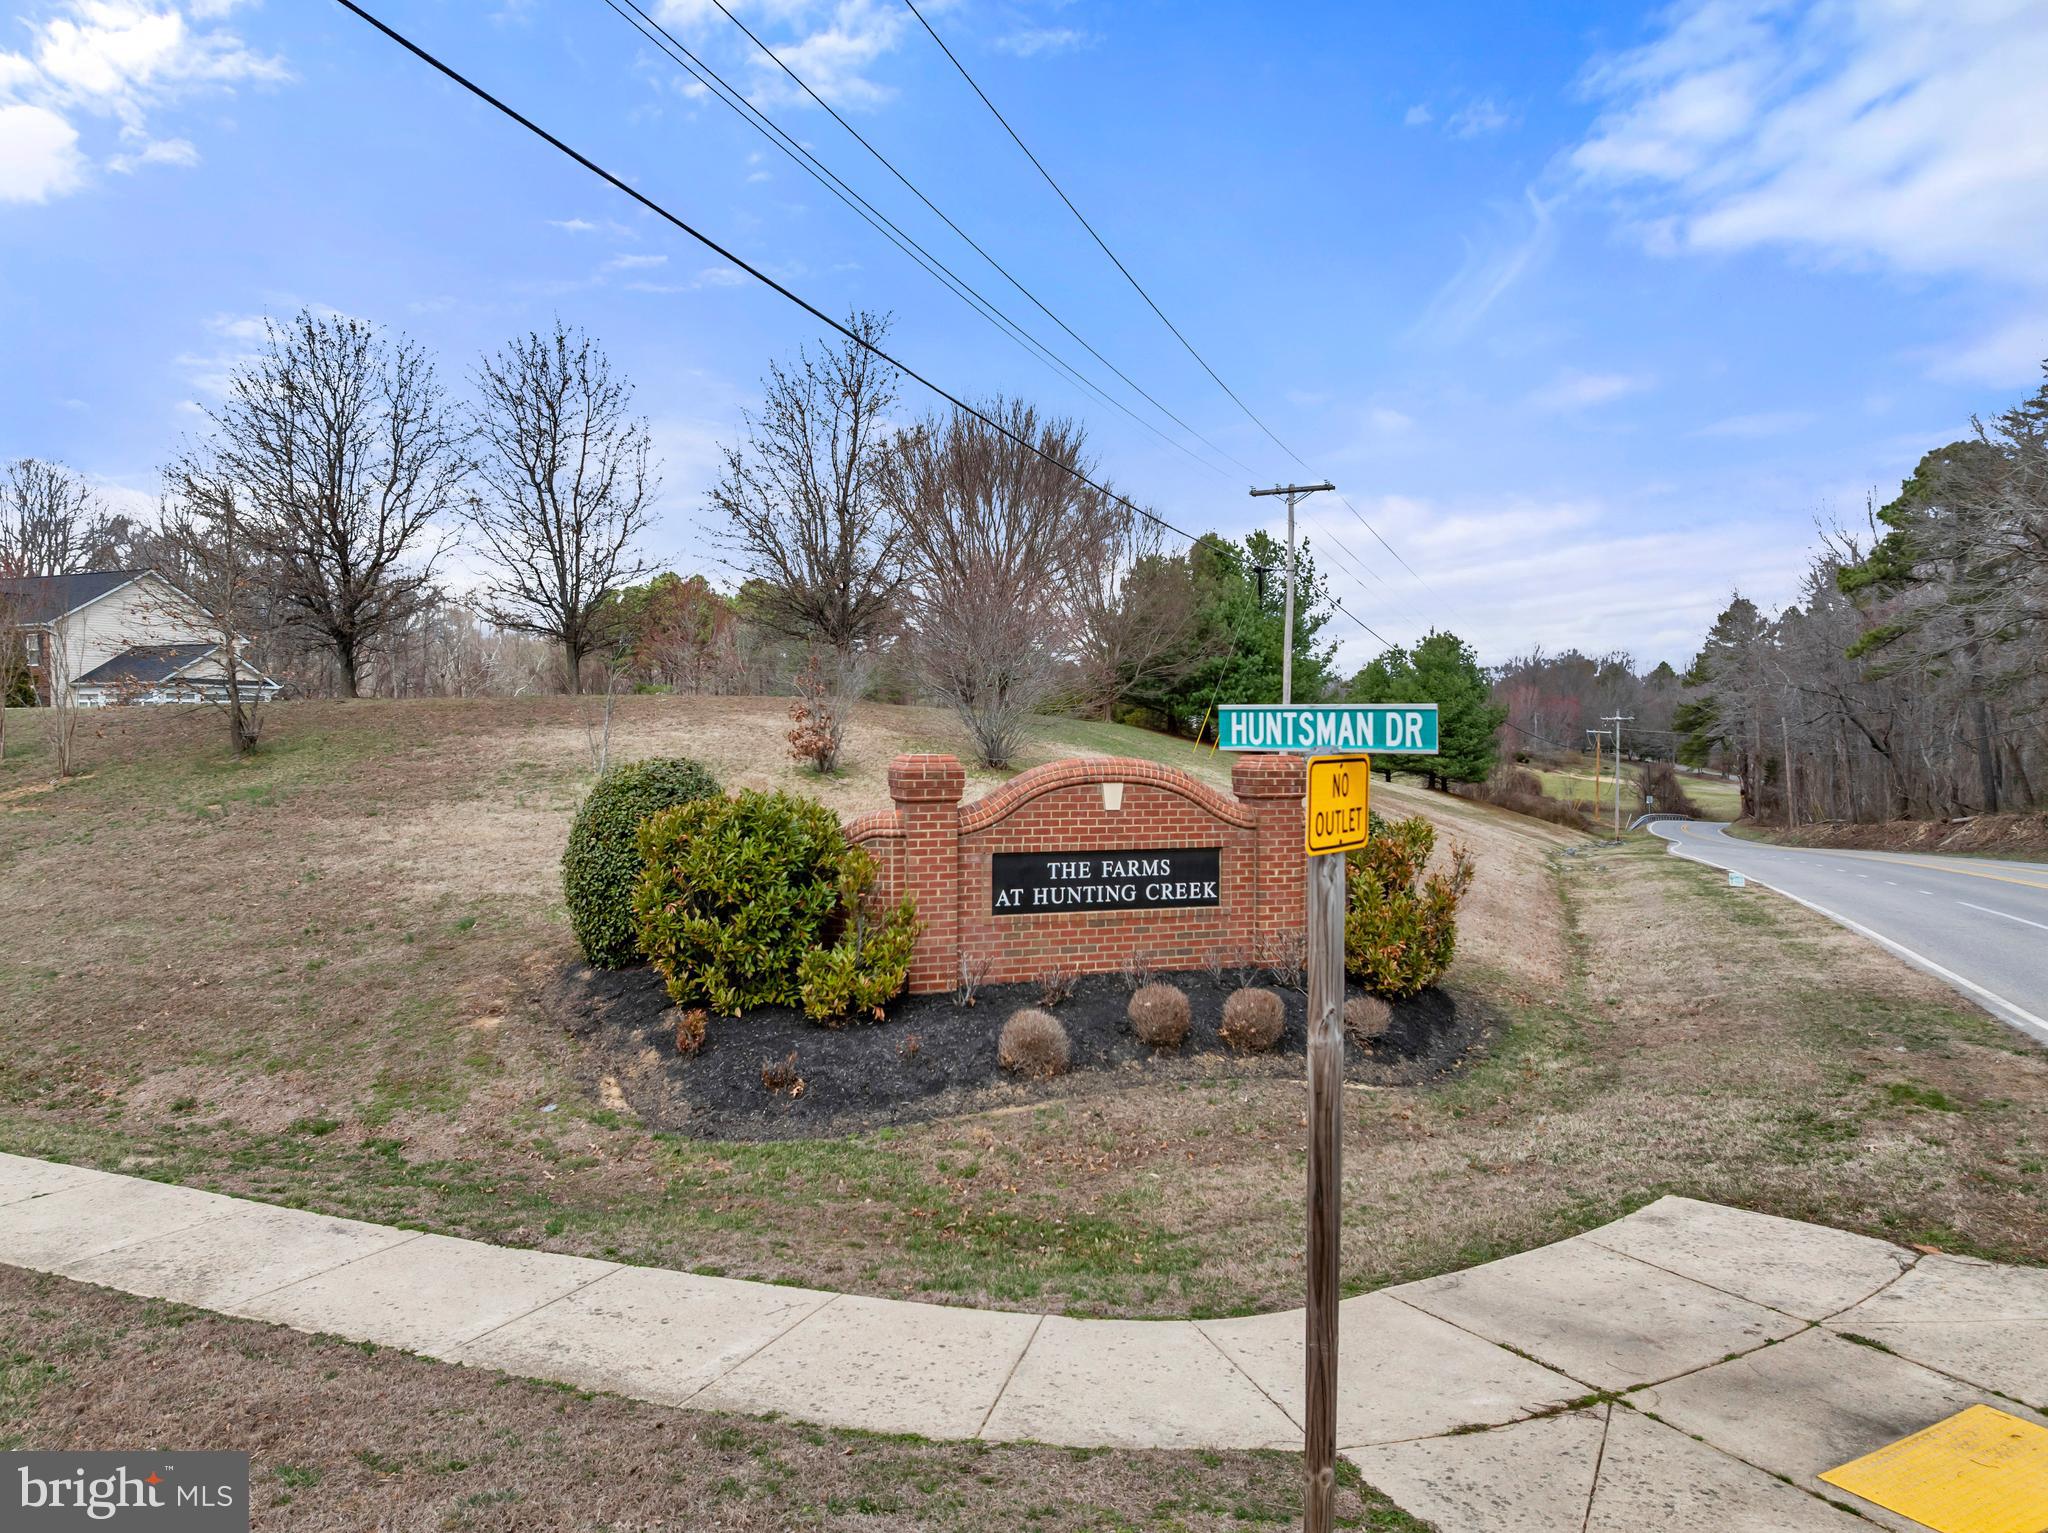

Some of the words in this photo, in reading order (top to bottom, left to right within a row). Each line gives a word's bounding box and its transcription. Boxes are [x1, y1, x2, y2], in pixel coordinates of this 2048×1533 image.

[1230, 711, 1374, 747] HUNTSMAN
[1386, 712, 1423, 748] DR
[1332, 772, 1349, 798] NO
[1315, 807, 1362, 837] OUTLET
[1047, 861, 1091, 880] THE
[1101, 859, 1171, 878] FARMS
[995, 888, 1024, 907] AT
[1032, 884, 1137, 906] HUNTING
[1145, 881, 1218, 900] CREEK
